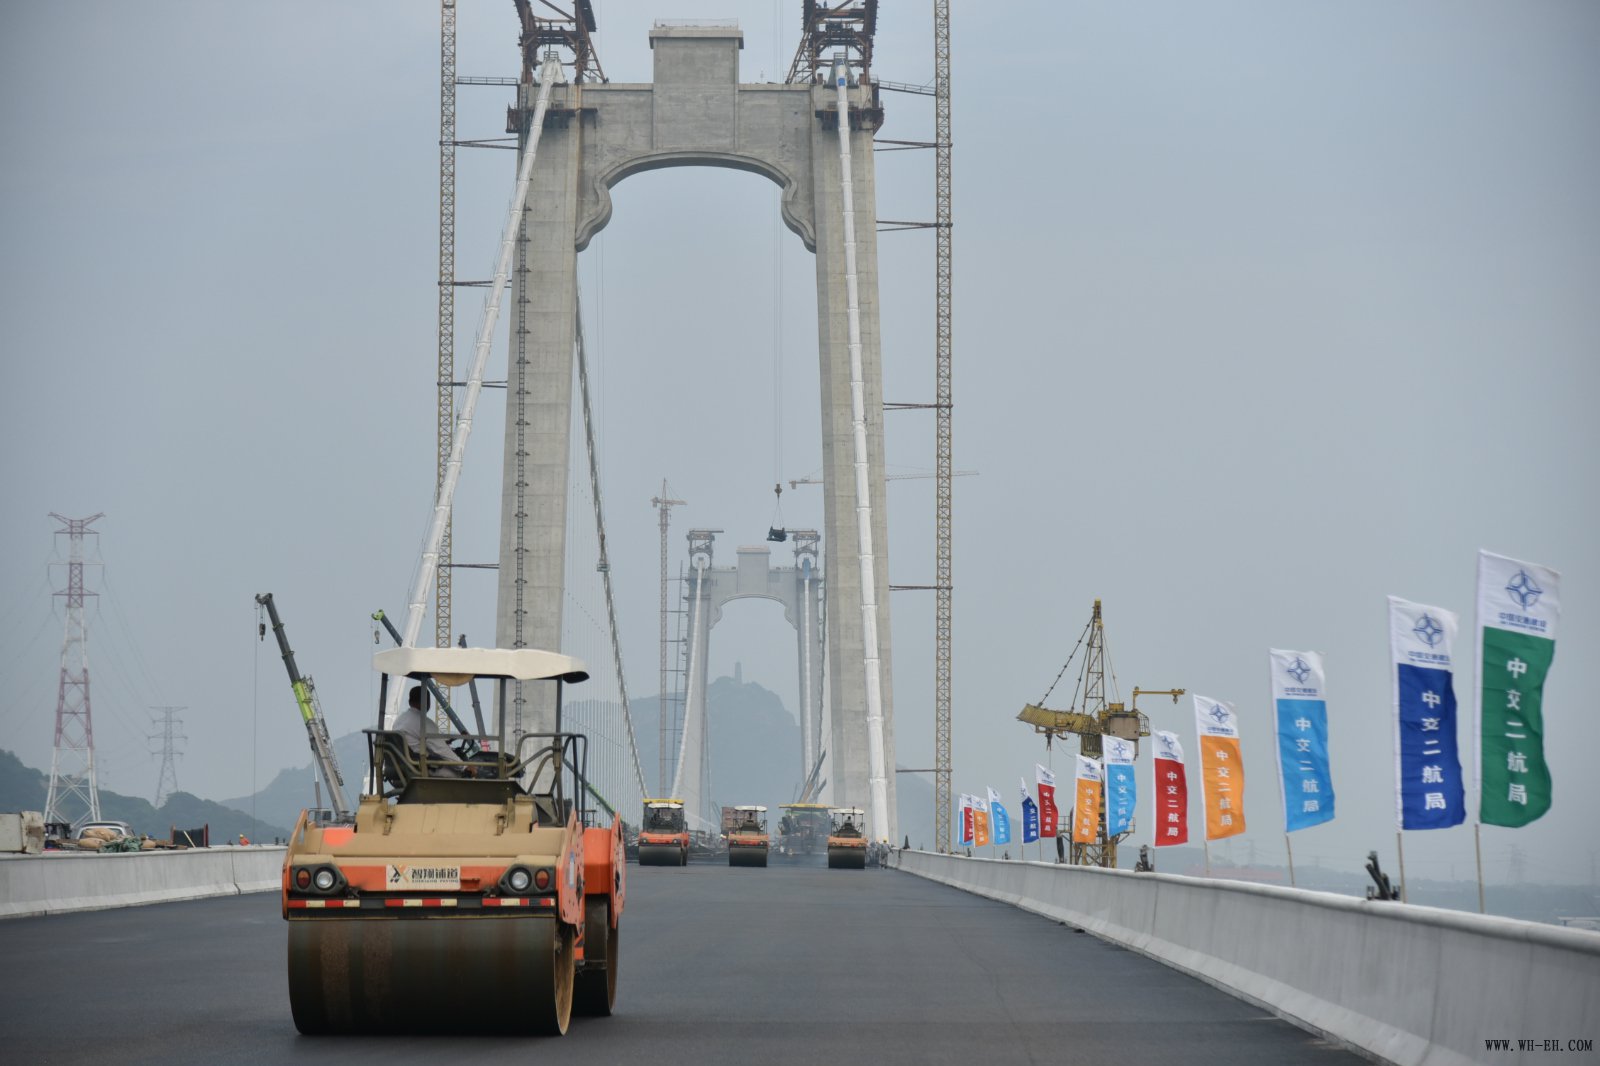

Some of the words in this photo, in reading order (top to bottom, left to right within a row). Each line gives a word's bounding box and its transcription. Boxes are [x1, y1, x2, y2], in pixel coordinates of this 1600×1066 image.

[1295, 717, 1319, 812] 中交二航局
[1421, 690, 1446, 810] 中交二航局
[1505, 657, 1528, 805] 中交二航局
[1117, 773, 1128, 827] 中交二航局
[1167, 771, 1179, 837] 中交二航局
[1216, 750, 1232, 826] 中交二航局
[412, 868, 458, 879] 智翔铺道
